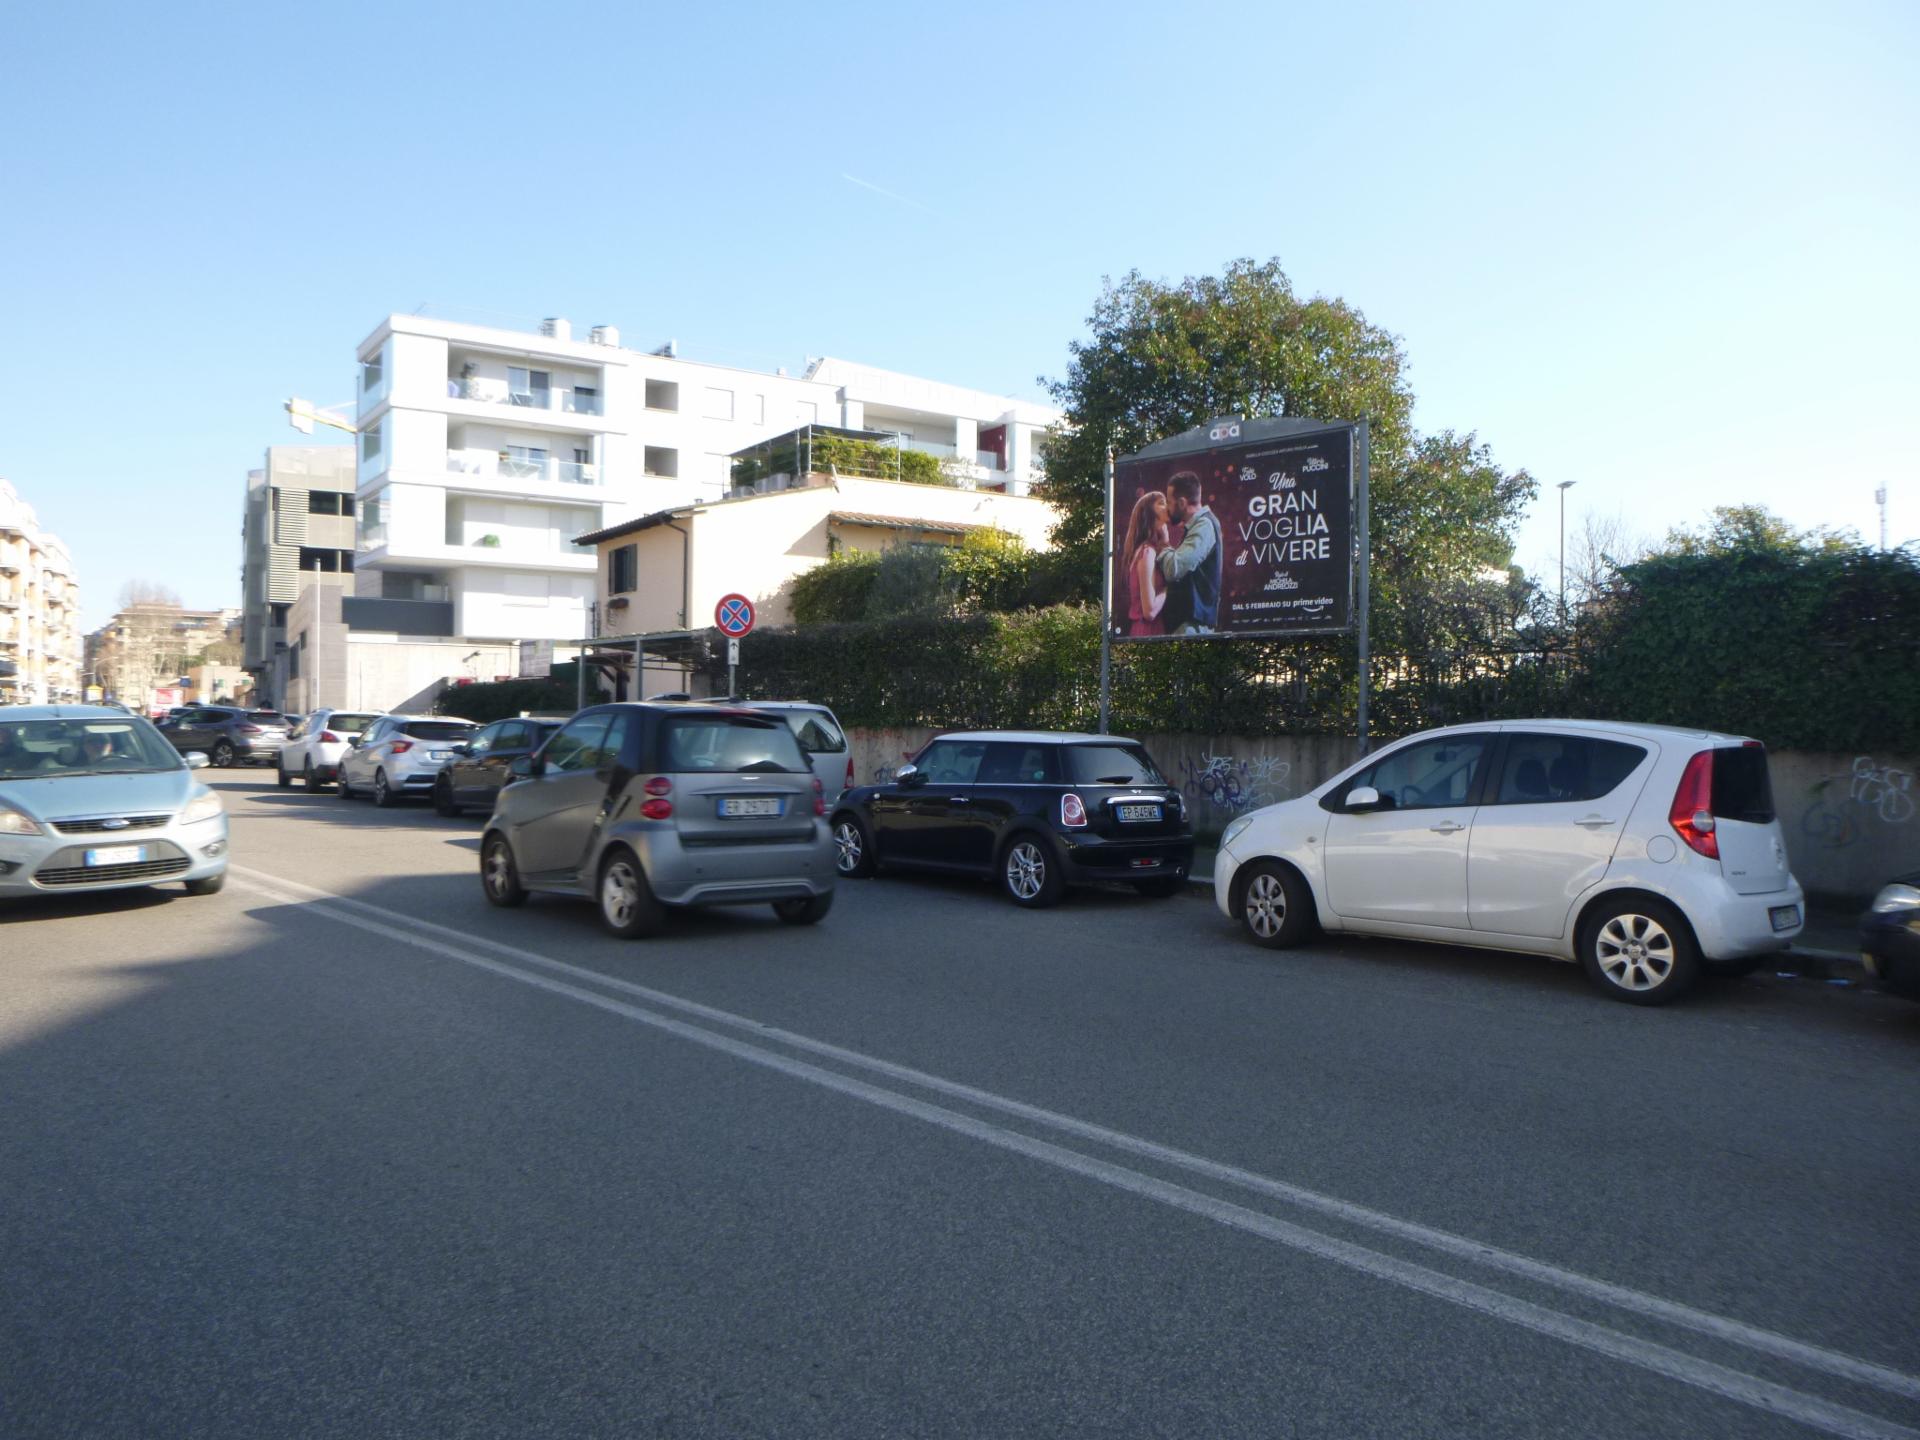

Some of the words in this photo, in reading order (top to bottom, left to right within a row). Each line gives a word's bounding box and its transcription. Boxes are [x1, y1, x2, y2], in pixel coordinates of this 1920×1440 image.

[1269, 472, 1296, 491] Una
[1249, 489, 1317, 517] GRAN
[1239, 514, 1329, 542] VOGLIA
[1235, 550, 1248, 566] di
[1251, 537, 1331, 565] VIVERE
[1232, 602, 1244, 611] DAL
[1250, 600, 1281, 610] FEBBRAIO
[1282, 600, 1291, 608] SU
[1293, 597, 1313, 608] prime
[1314, 596, 1333, 606] video
